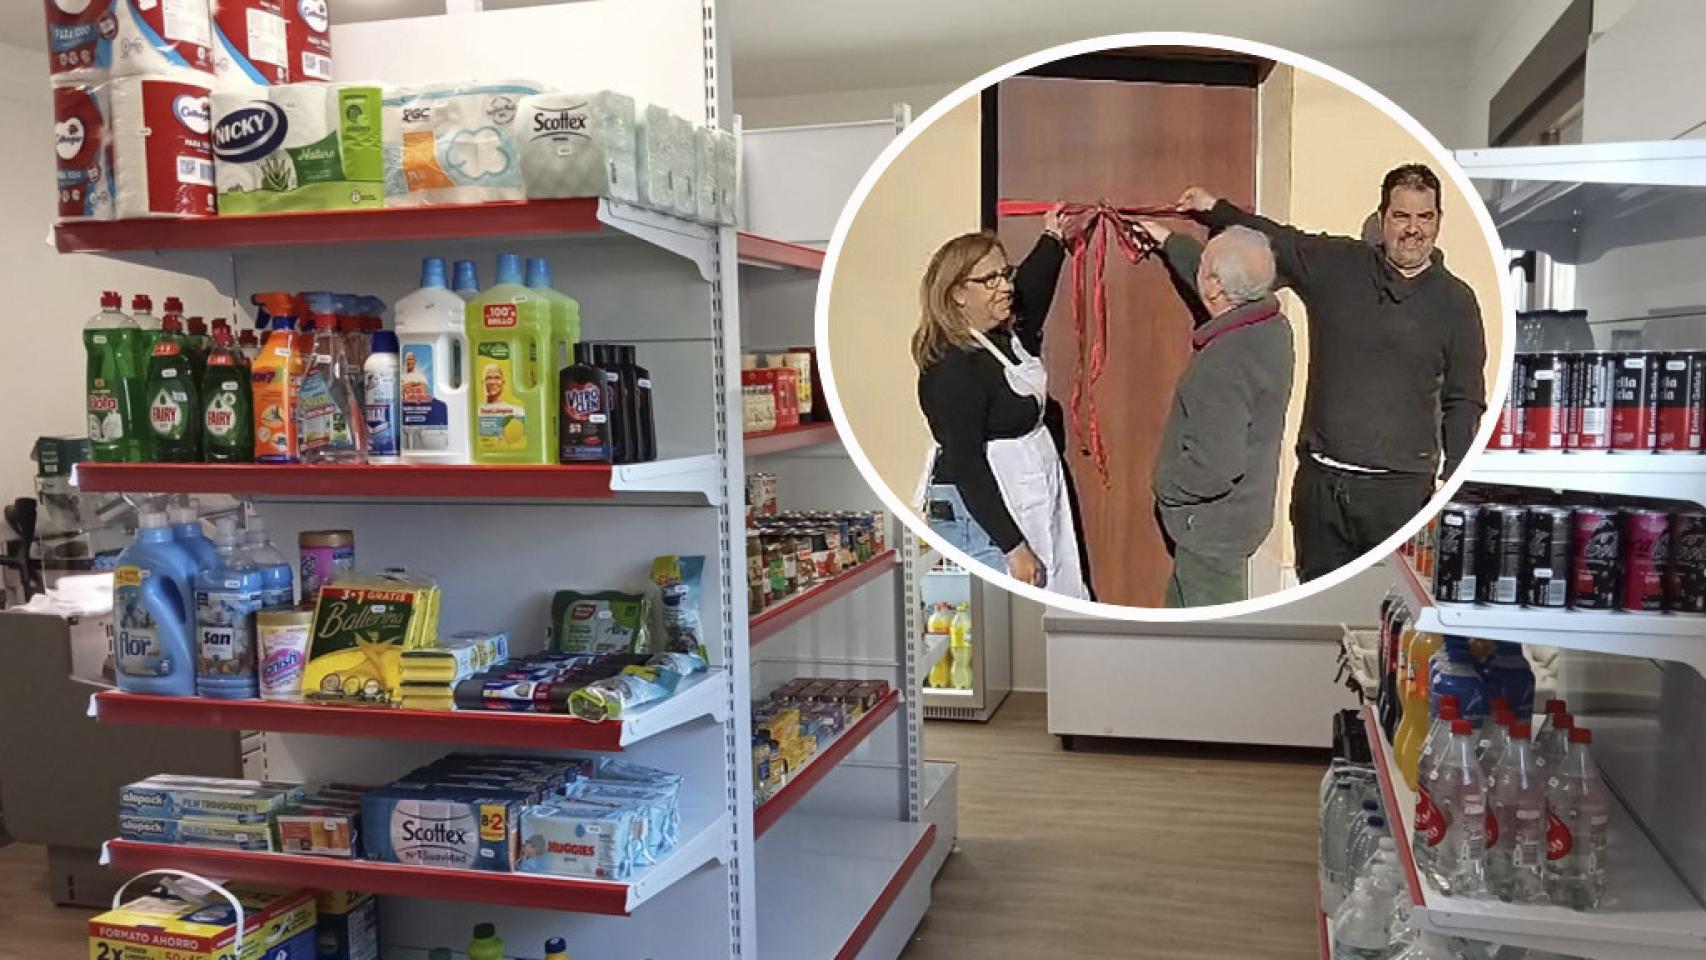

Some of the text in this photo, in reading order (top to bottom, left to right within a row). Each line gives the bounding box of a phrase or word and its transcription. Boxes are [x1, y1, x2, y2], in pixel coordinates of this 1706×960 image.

[216, 112, 266, 144] NICKY
[533, 110, 587, 131] Scottex
[487, 317, 514, 326] BRILLO
[152, 407, 177, 423] FAIRY
[207, 411, 232, 426] FAIRY
[318, 601, 404, 639] Ballerina
[119, 631, 152, 658] flor
[204, 631, 231, 646] san
[402, 820, 466, 846] Scottex
[547, 840, 596, 857] HUGGIES
[99, 926, 199, 950] FORMATO AHORRO
